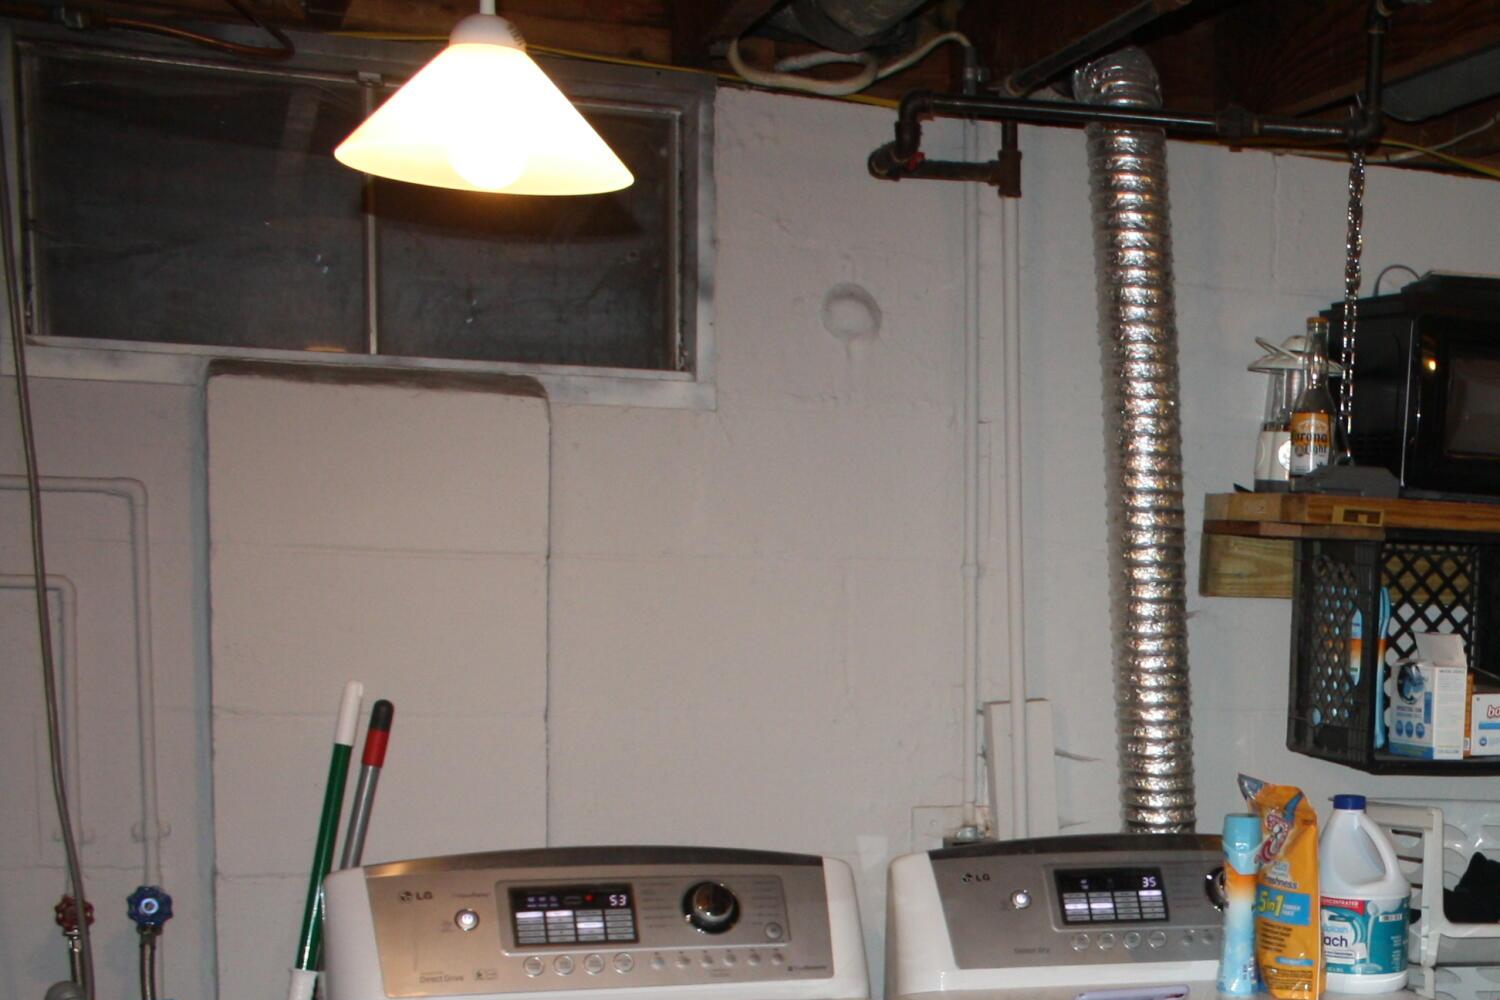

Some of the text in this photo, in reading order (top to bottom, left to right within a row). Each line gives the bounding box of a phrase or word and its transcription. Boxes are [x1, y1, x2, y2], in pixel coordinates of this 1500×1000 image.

[975, 873, 991, 882] LG
[415, 891, 433, 901] LG
[1323, 935, 1348, 948] ach
